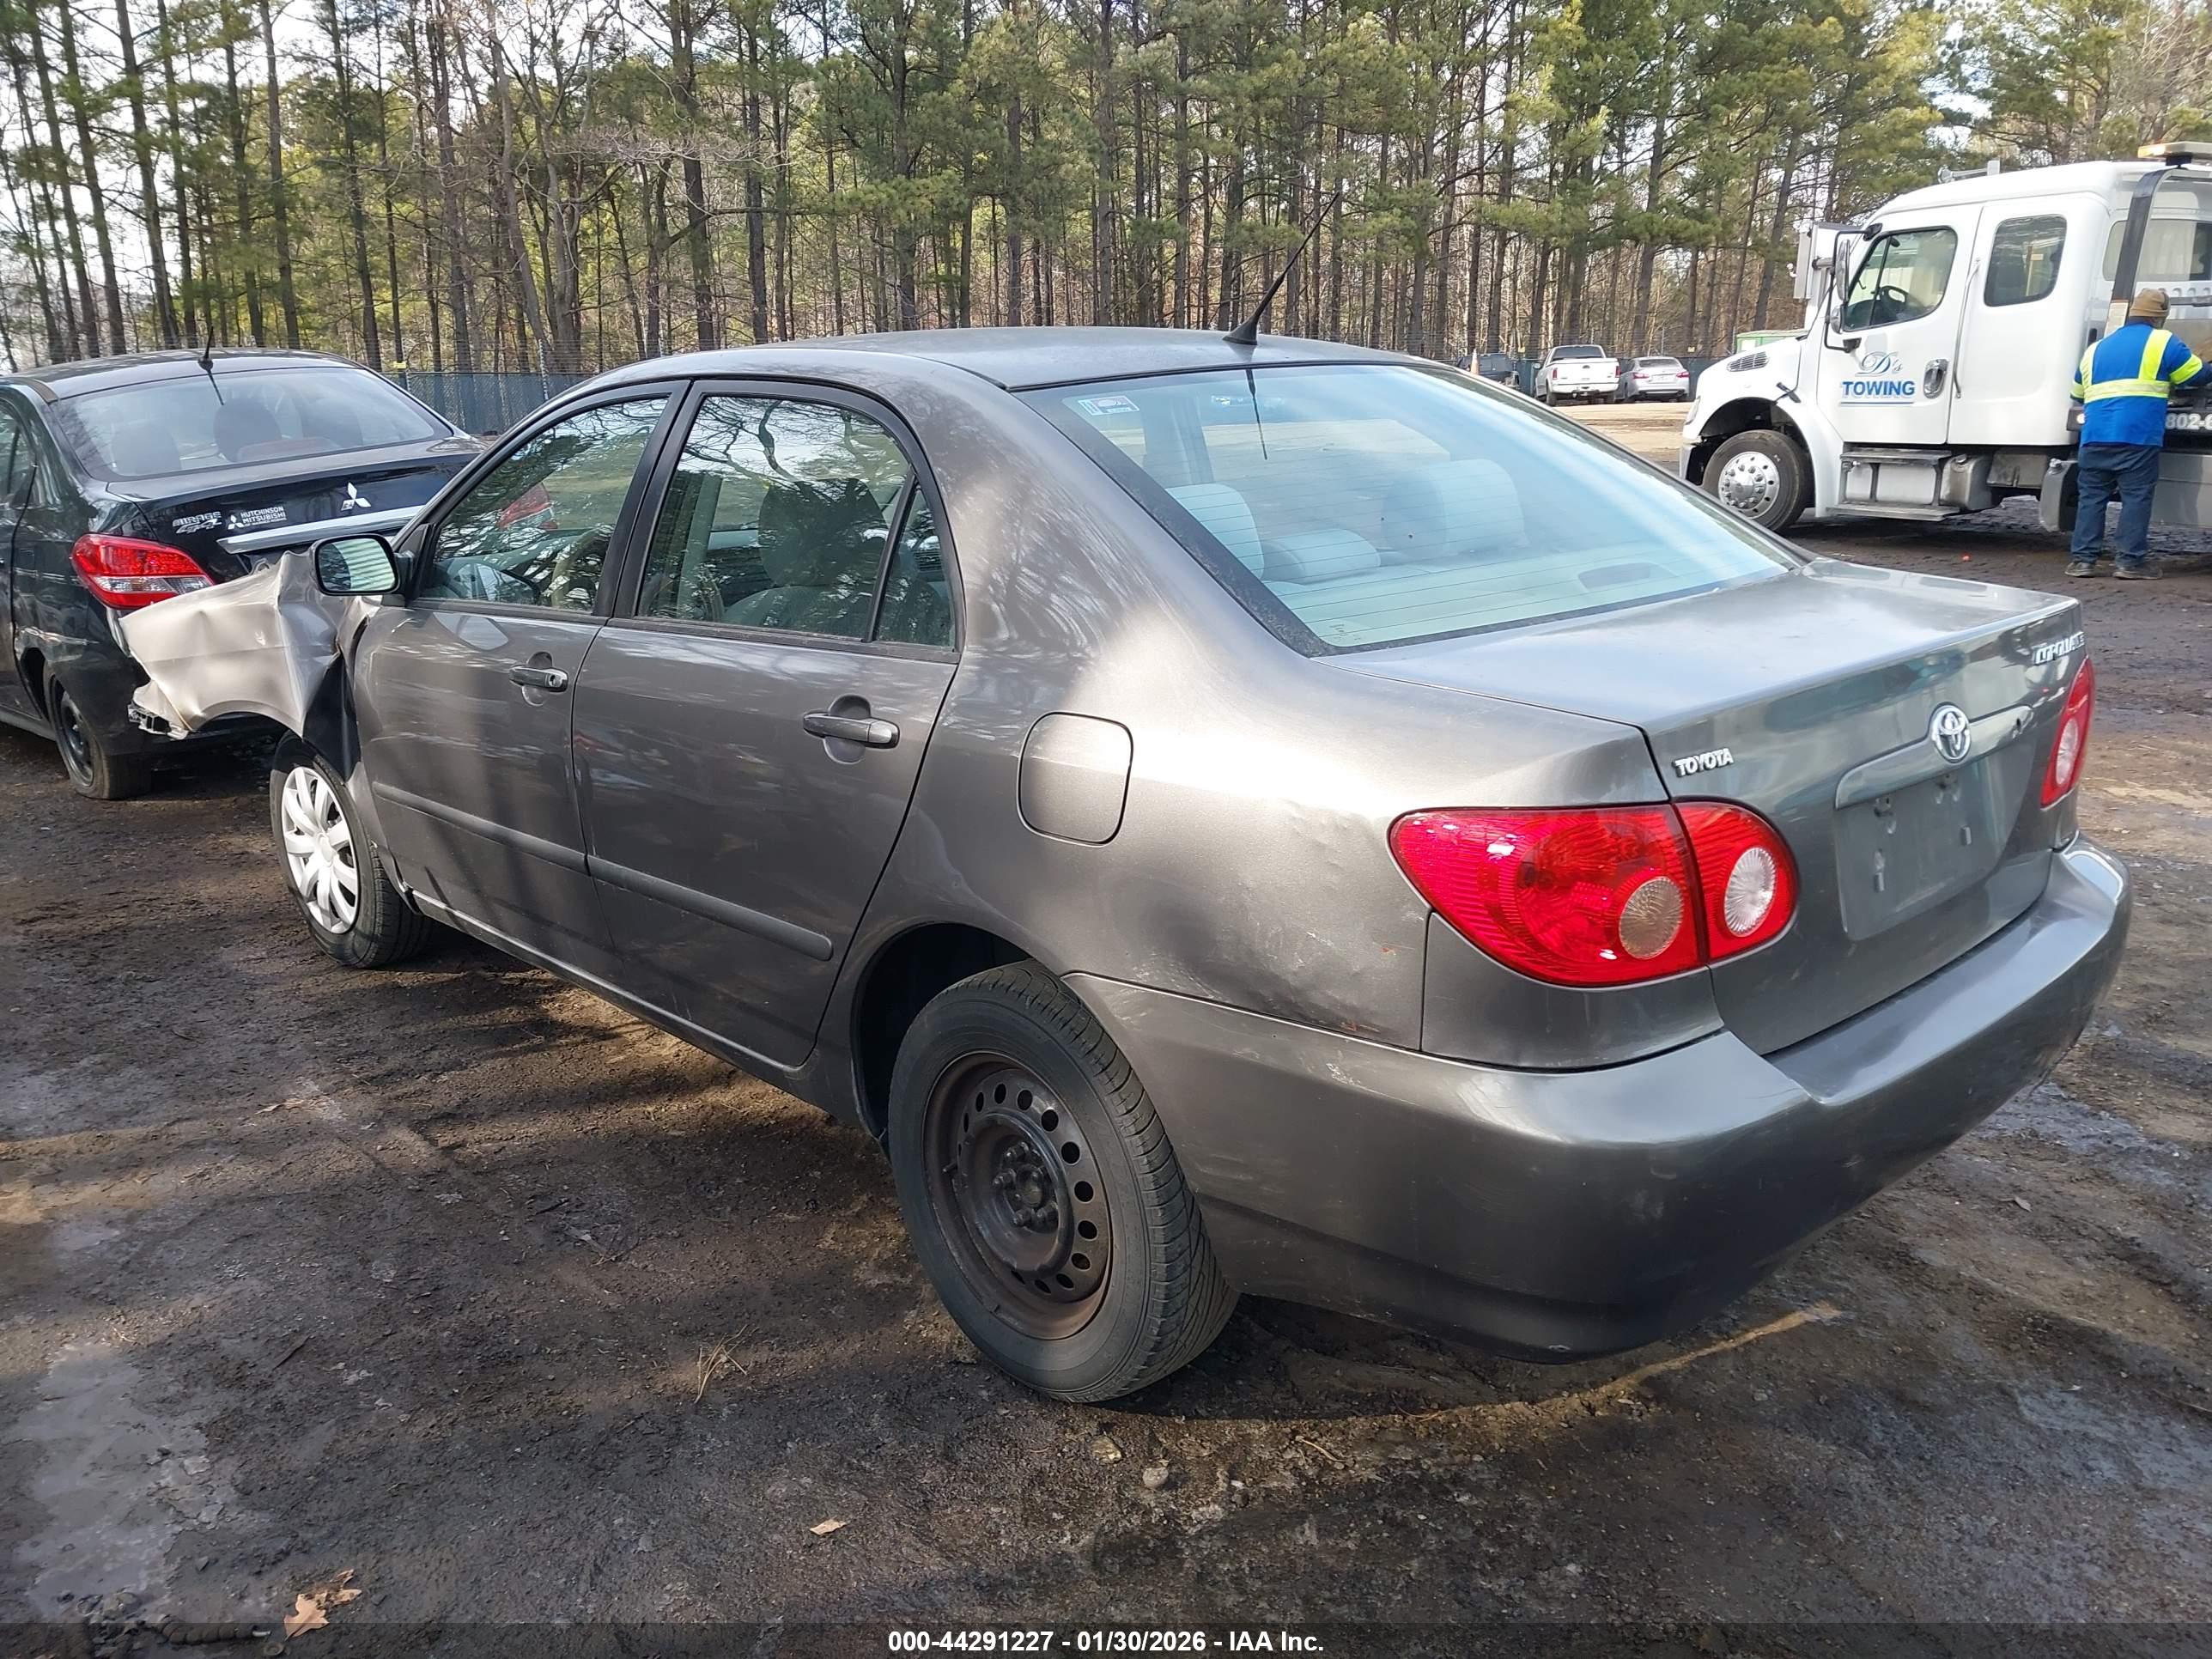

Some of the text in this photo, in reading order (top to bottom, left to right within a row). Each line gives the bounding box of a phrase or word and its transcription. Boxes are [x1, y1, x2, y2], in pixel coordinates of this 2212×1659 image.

[1842, 380, 1915, 398] TOWING
[172, 511, 222, 527] MIRAGE
[240, 506, 284, 519] HUTCHINSON
[242, 512, 287, 524] MITSUBISHI
[1674, 748, 1734, 776] TOYOTA
